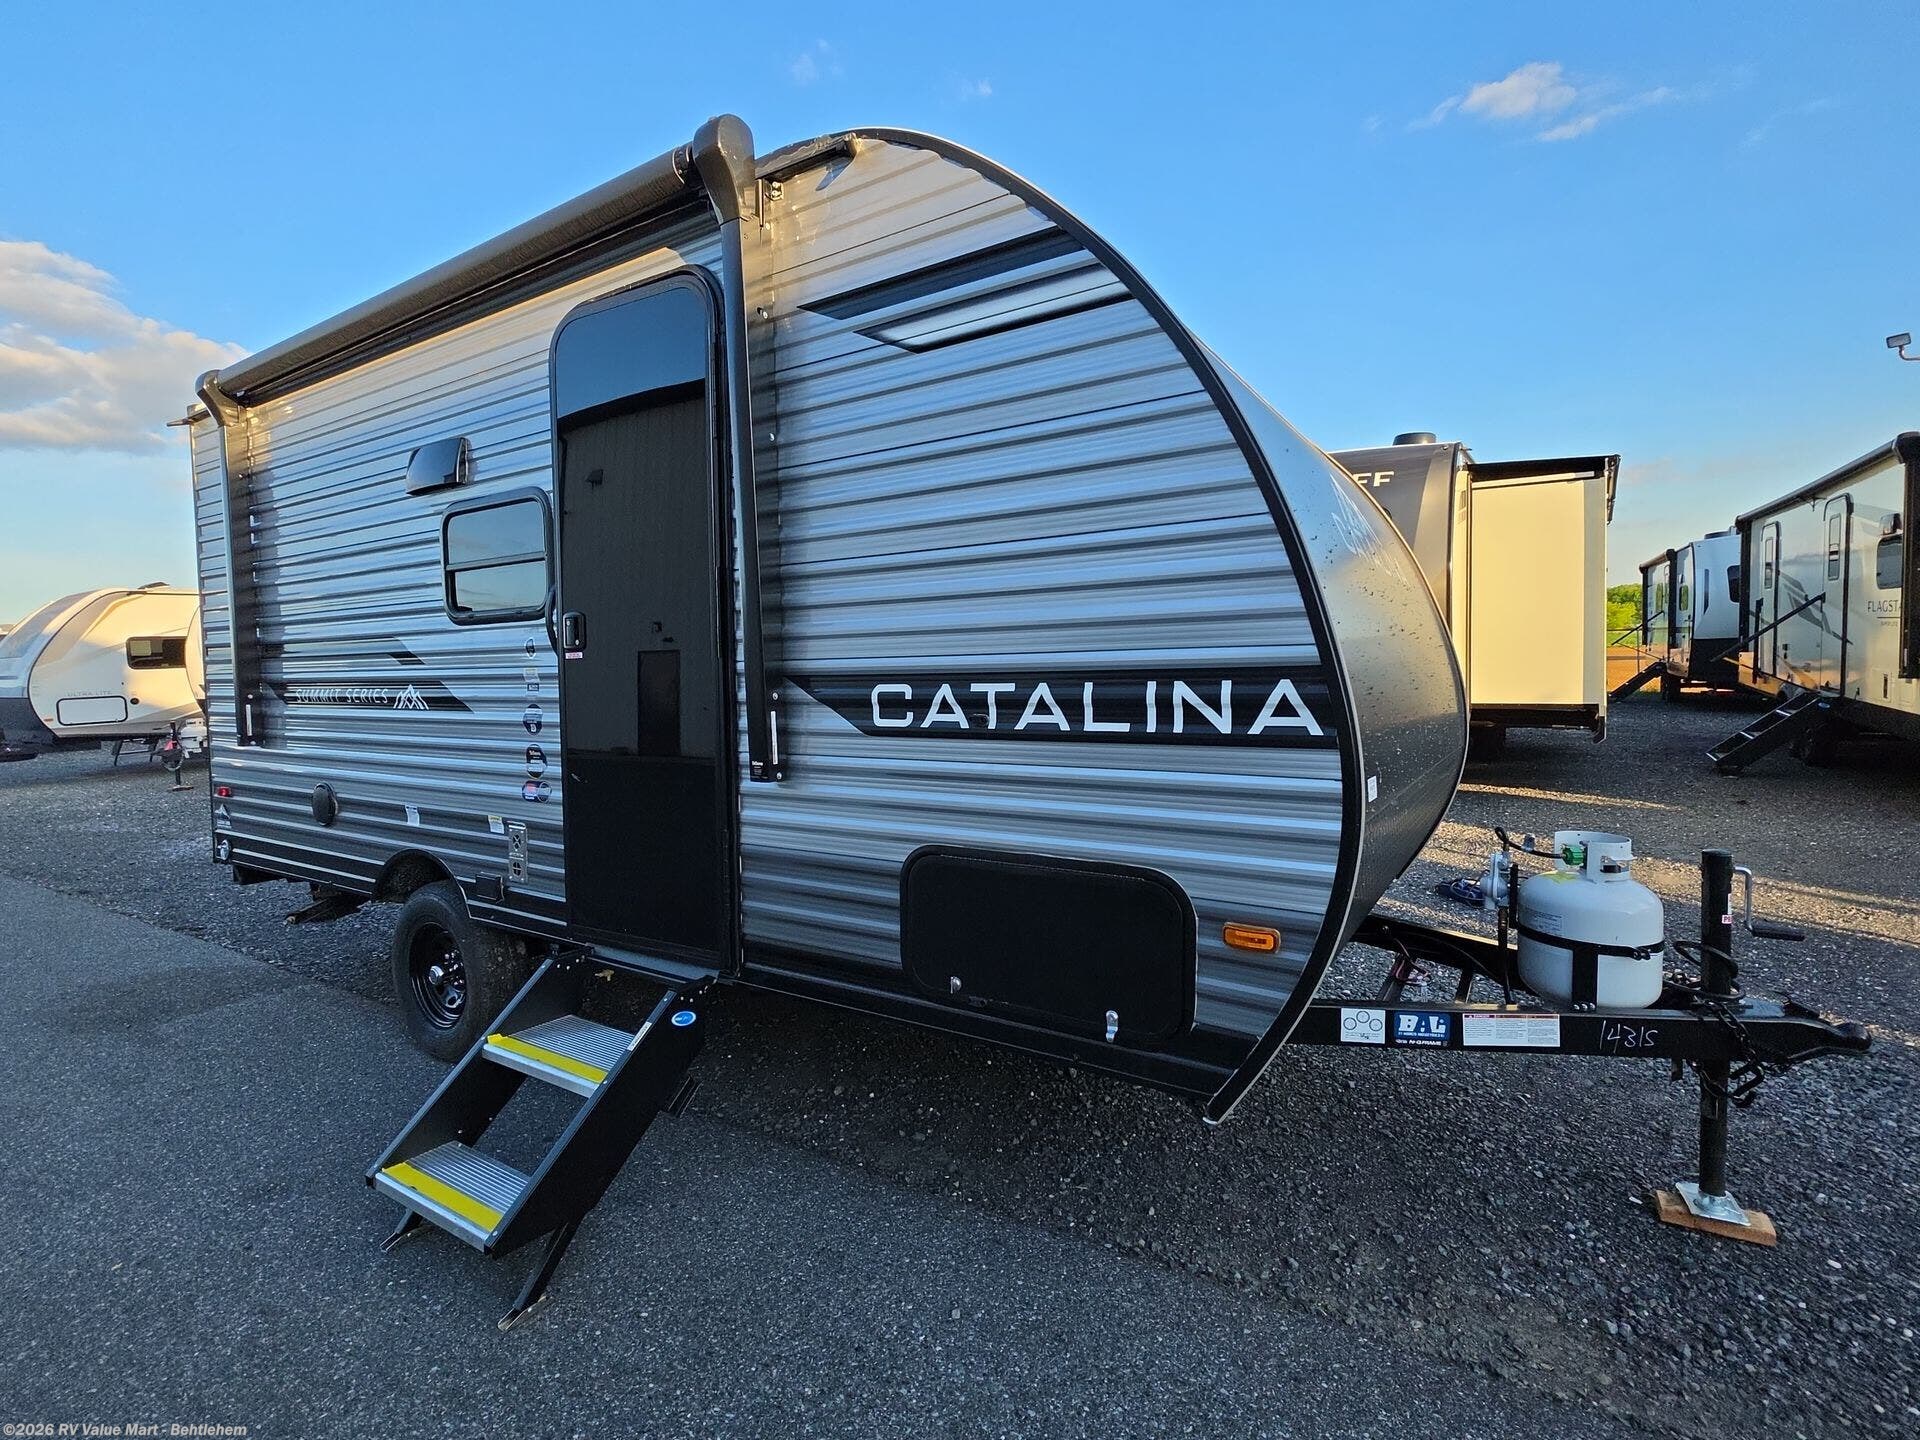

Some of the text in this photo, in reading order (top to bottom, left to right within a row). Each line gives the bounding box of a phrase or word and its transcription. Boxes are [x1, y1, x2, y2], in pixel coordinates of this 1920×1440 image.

[1867, 600, 1901, 612] FLAGST
[296, 688, 388, 703] SUMMIT SERIES
[870, 679, 1324, 736] CATALINA
